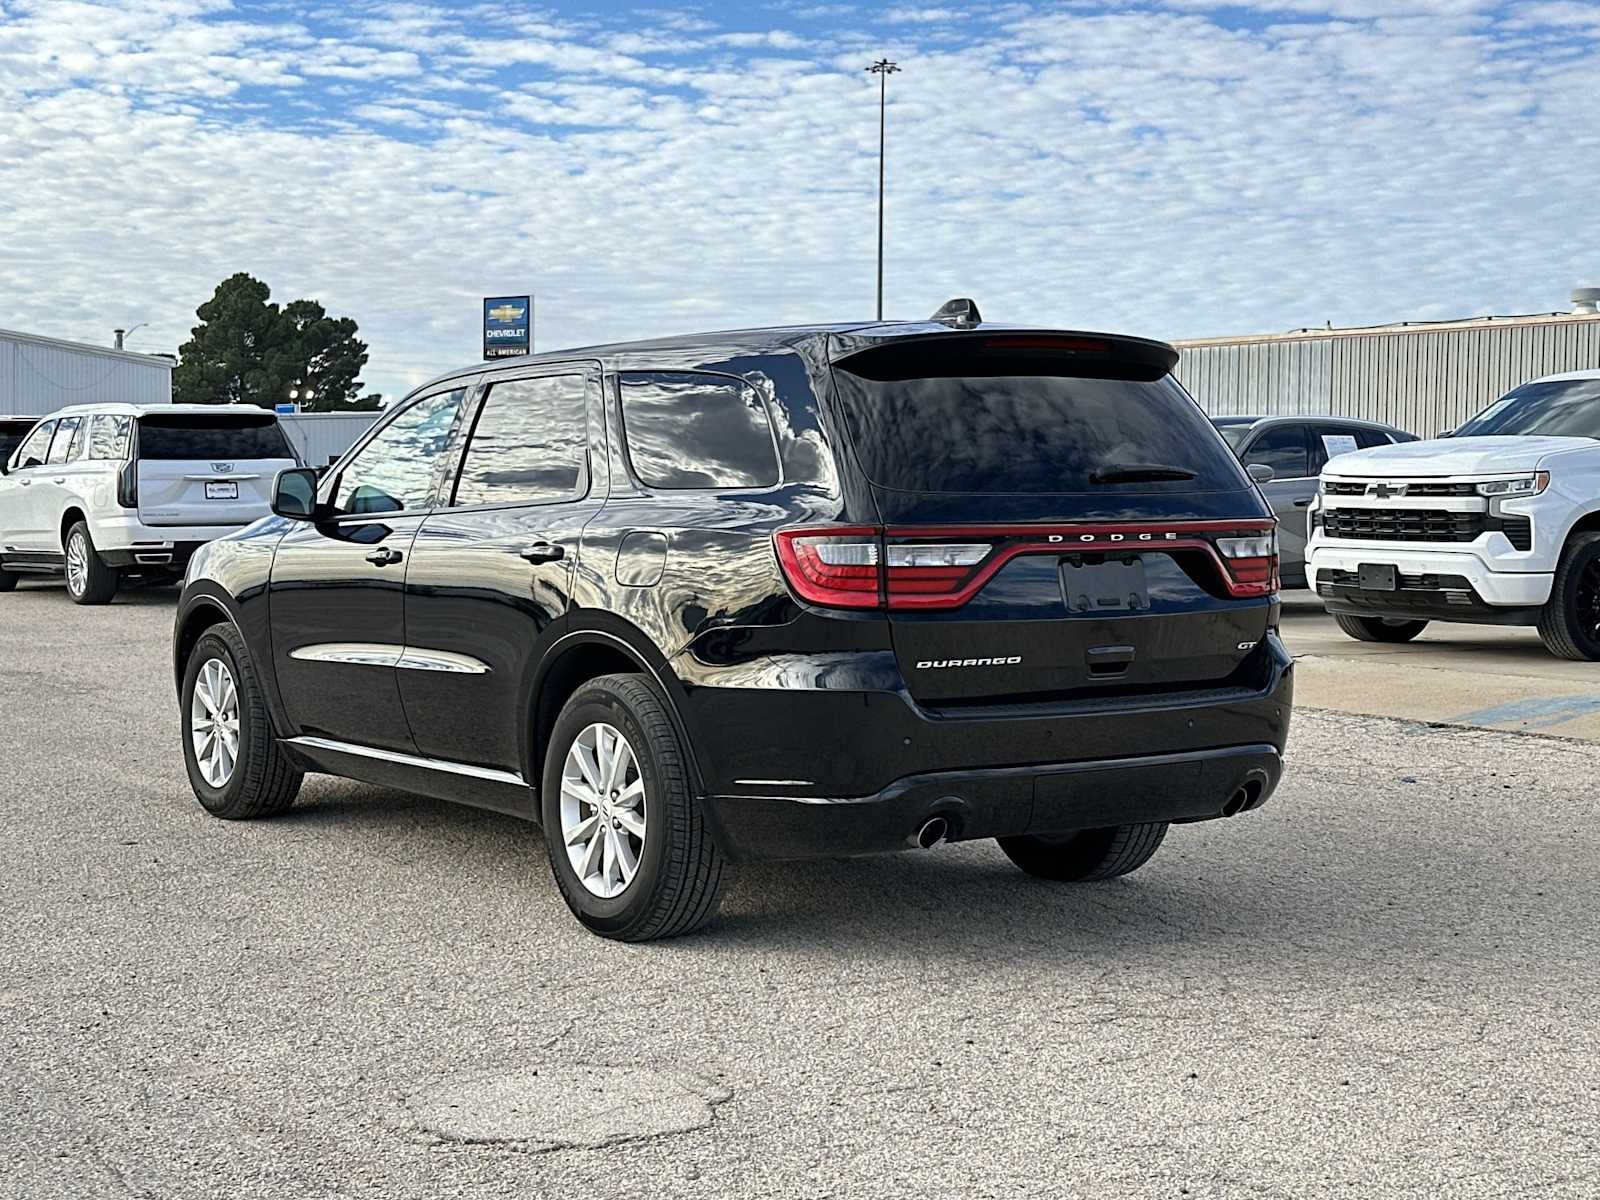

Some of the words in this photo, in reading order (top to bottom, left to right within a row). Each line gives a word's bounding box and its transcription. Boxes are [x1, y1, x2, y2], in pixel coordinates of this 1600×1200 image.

[486, 329, 525, 338] CHEVROLET
[1048, 532, 1177, 543] DODGE
[1237, 641, 1258, 650] GT
[916, 656, 1022, 669] DURANGO
